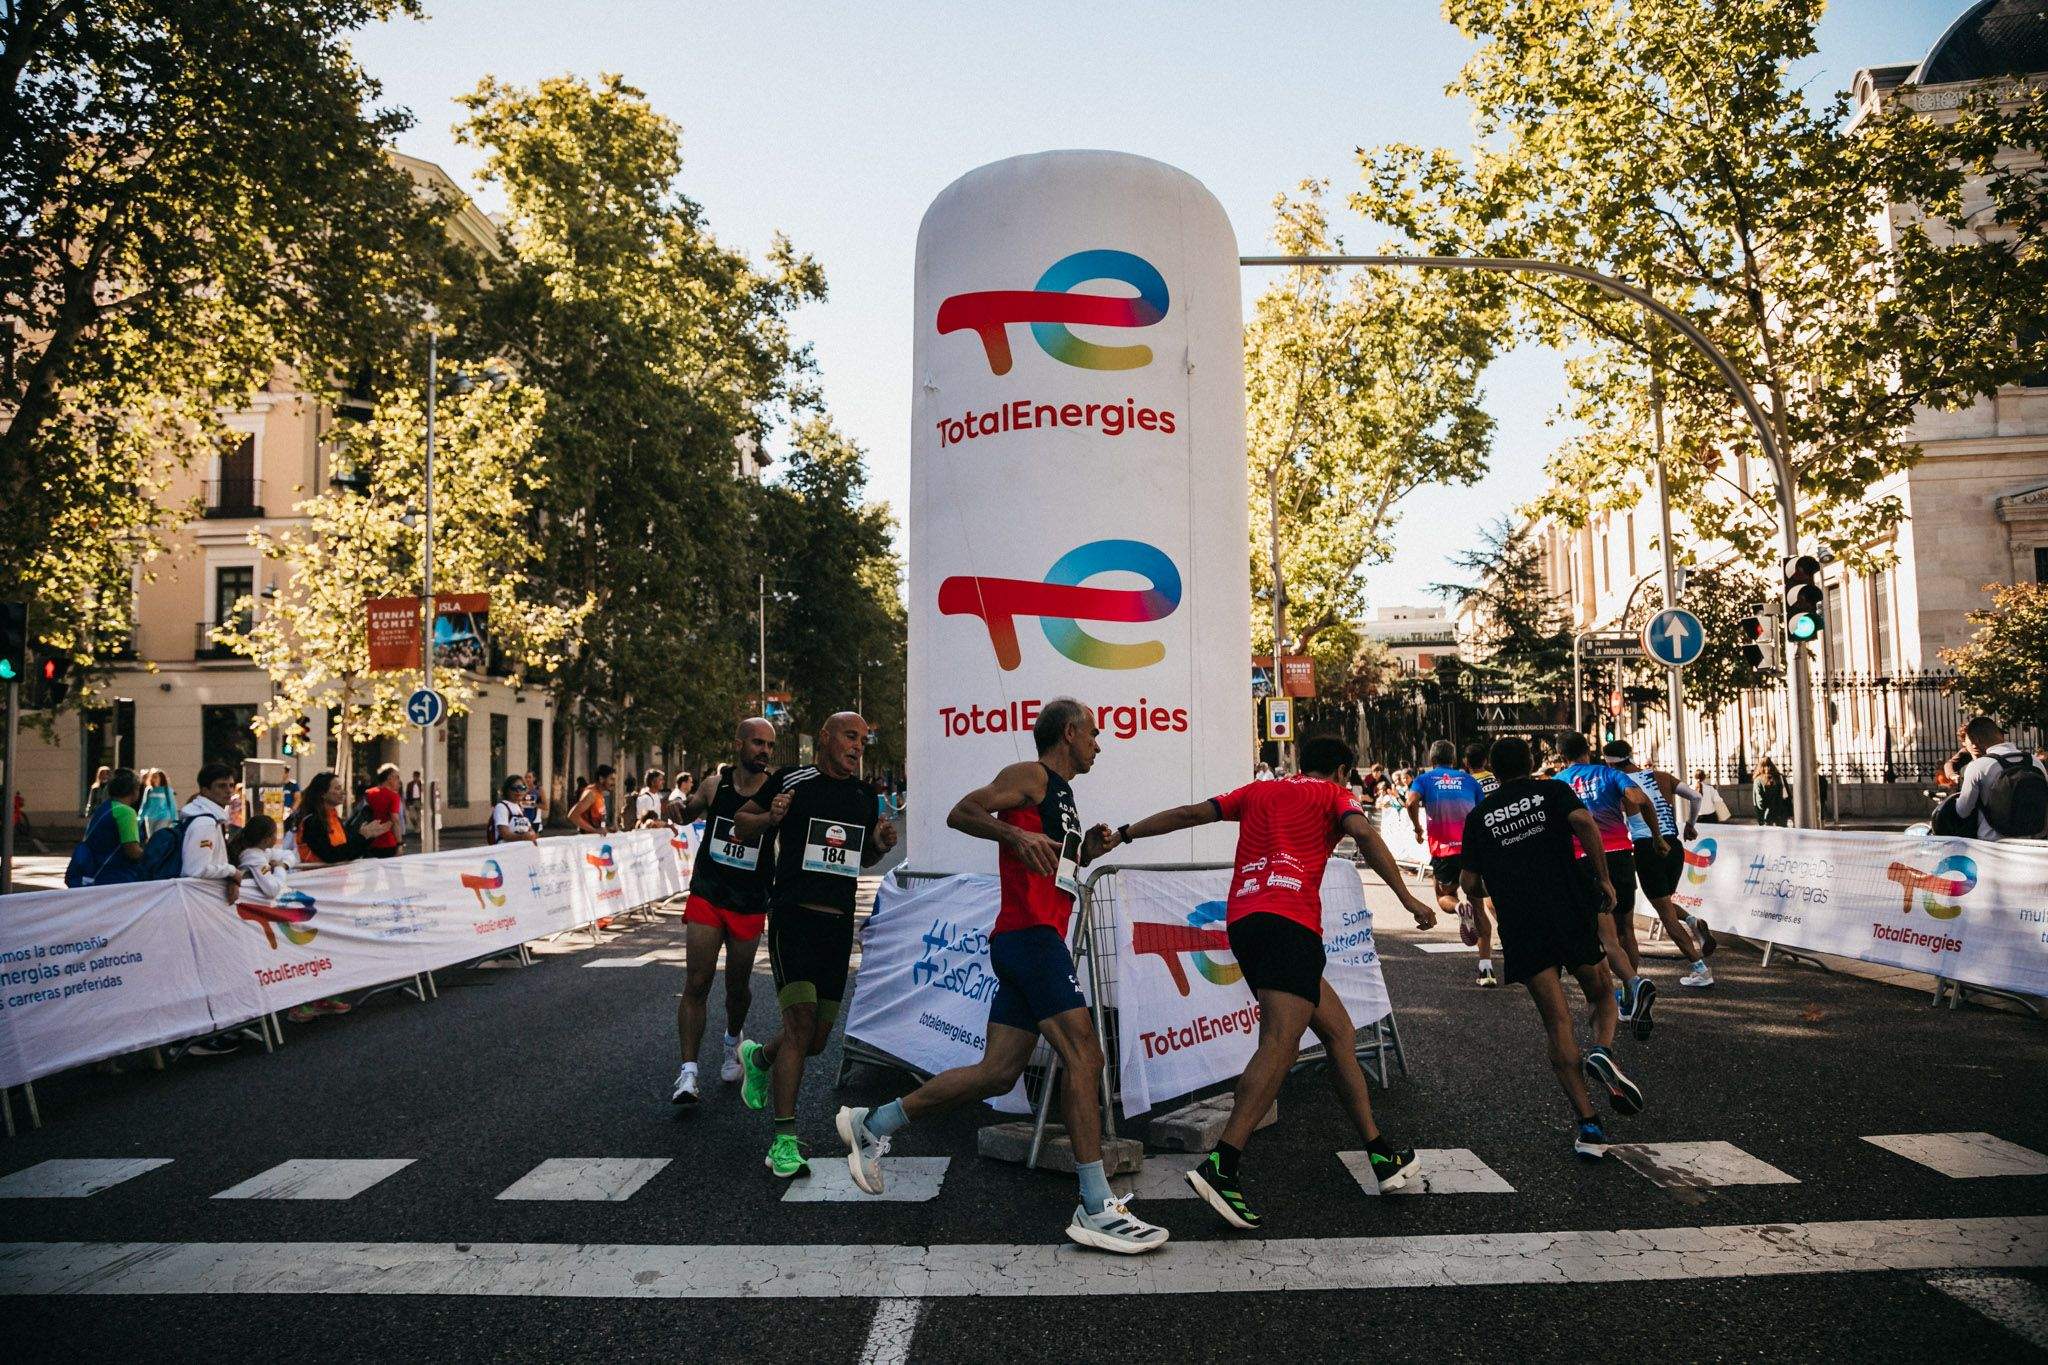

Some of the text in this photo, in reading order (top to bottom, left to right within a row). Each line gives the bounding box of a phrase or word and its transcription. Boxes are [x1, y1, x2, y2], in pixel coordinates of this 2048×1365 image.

[937, 398, 1176, 448] TotalEnergies
[439, 602, 461, 612] ISLA
[1595, 648, 1602, 656] LA
[939, 698, 1188, 739] TotalErgies
[1499, 723, 1544, 731] ARQUEOLÓGICO
[1484, 797, 1531, 827] asisa
[1491, 810, 1546, 838] Running
[722, 843, 746, 860] 418
[822, 846, 846, 865] 184
[1750, 909, 1802, 924] totalenergies.es
[2020, 908, 2048, 923] mul
[34, 945, 46, 958] la
[50, 936, 108, 956] compañía
[1871, 923, 1963, 953] TotalEnergies
[64, 961, 86, 976] que
[90, 952, 143, 972] patrocina
[255, 955, 333, 987] TotalEnergies
[9, 975, 123, 1008] carreras preferidas
[918, 1010, 986, 1051] totalenergies.es
[1140, 1000, 1261, 1058] TotalEnergie
